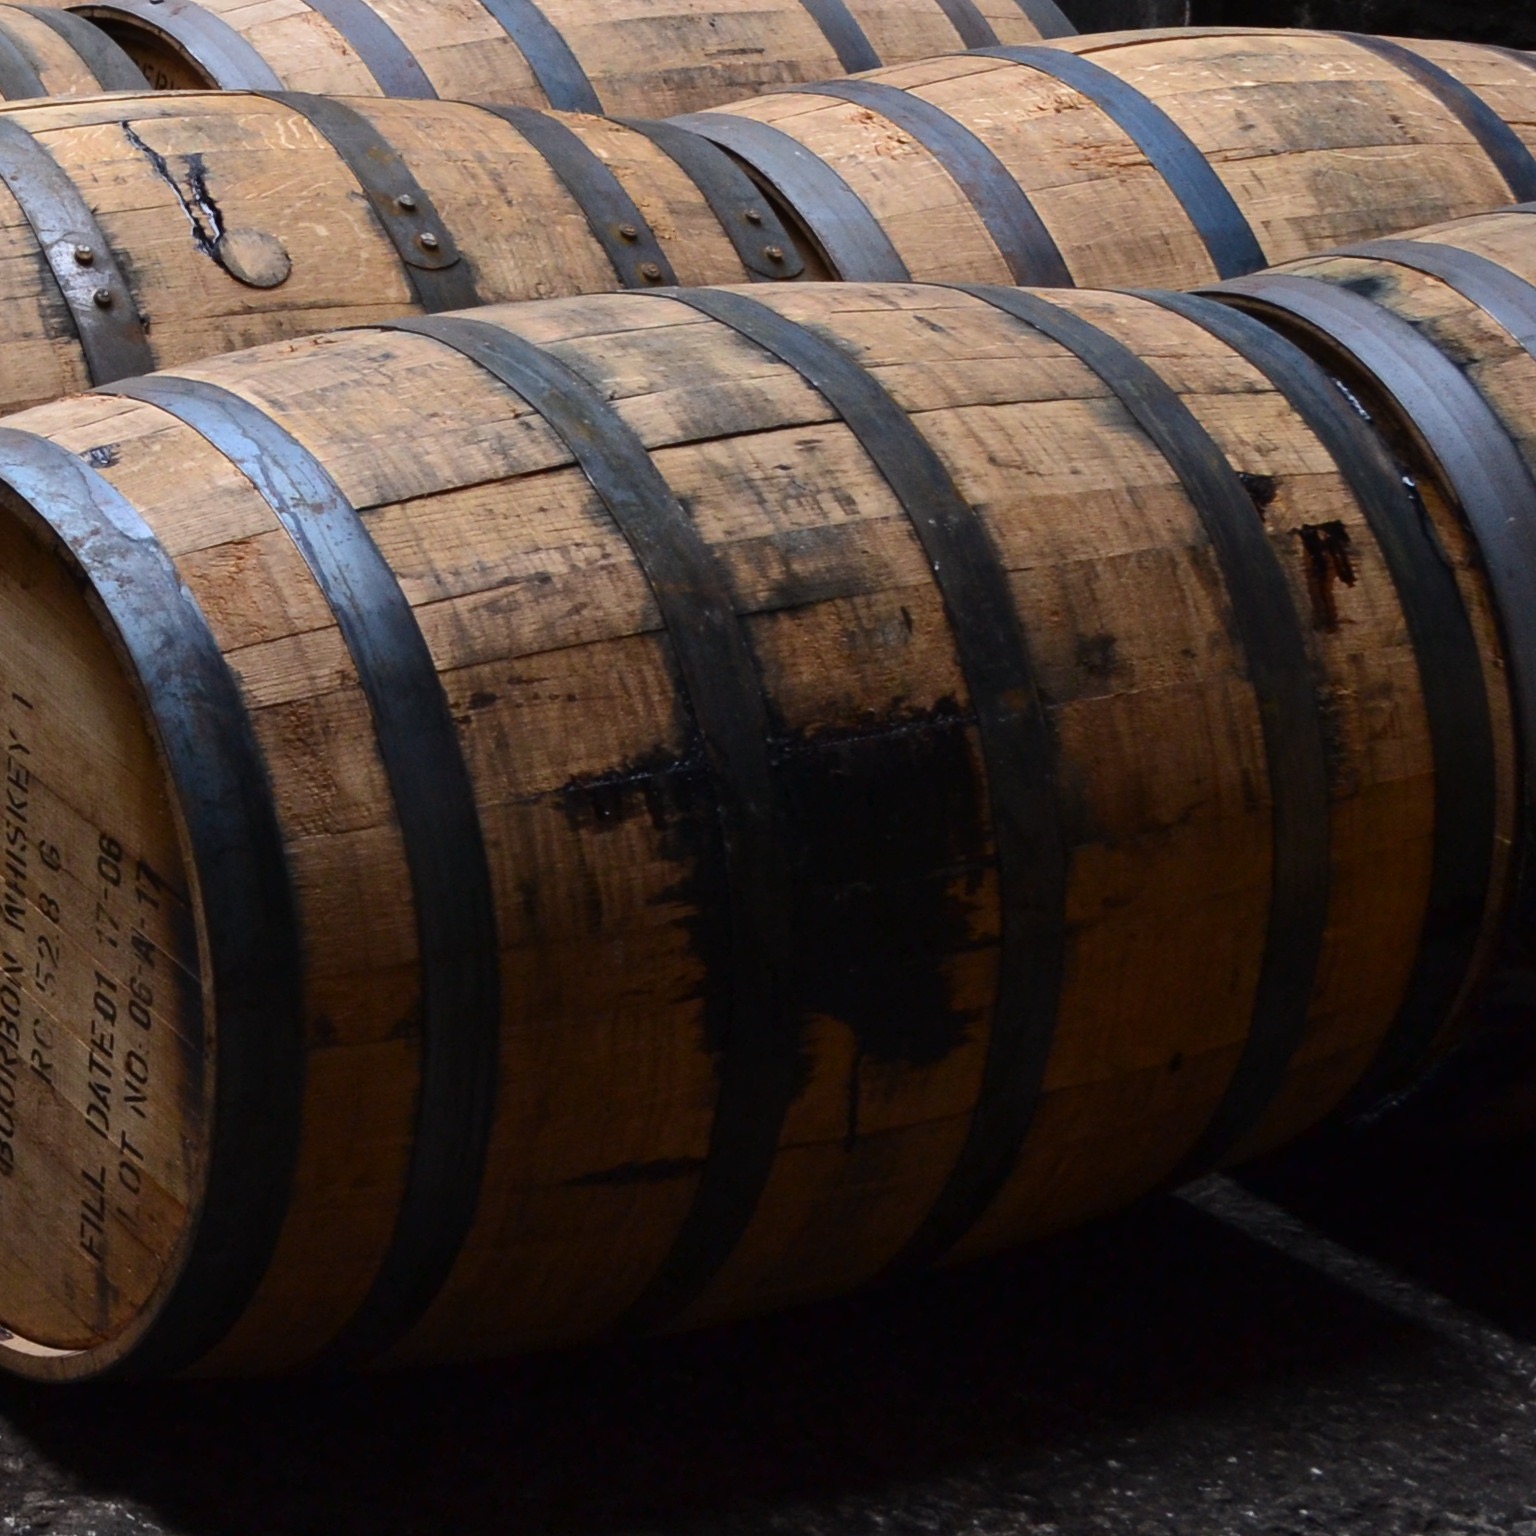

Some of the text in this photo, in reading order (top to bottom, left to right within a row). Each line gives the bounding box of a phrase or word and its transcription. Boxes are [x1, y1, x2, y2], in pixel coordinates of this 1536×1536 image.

[3, 726, 33, 934] WHISKEY
[29, 1017, 56, 1086] RC
[79, 1164, 106, 1262] FILL
